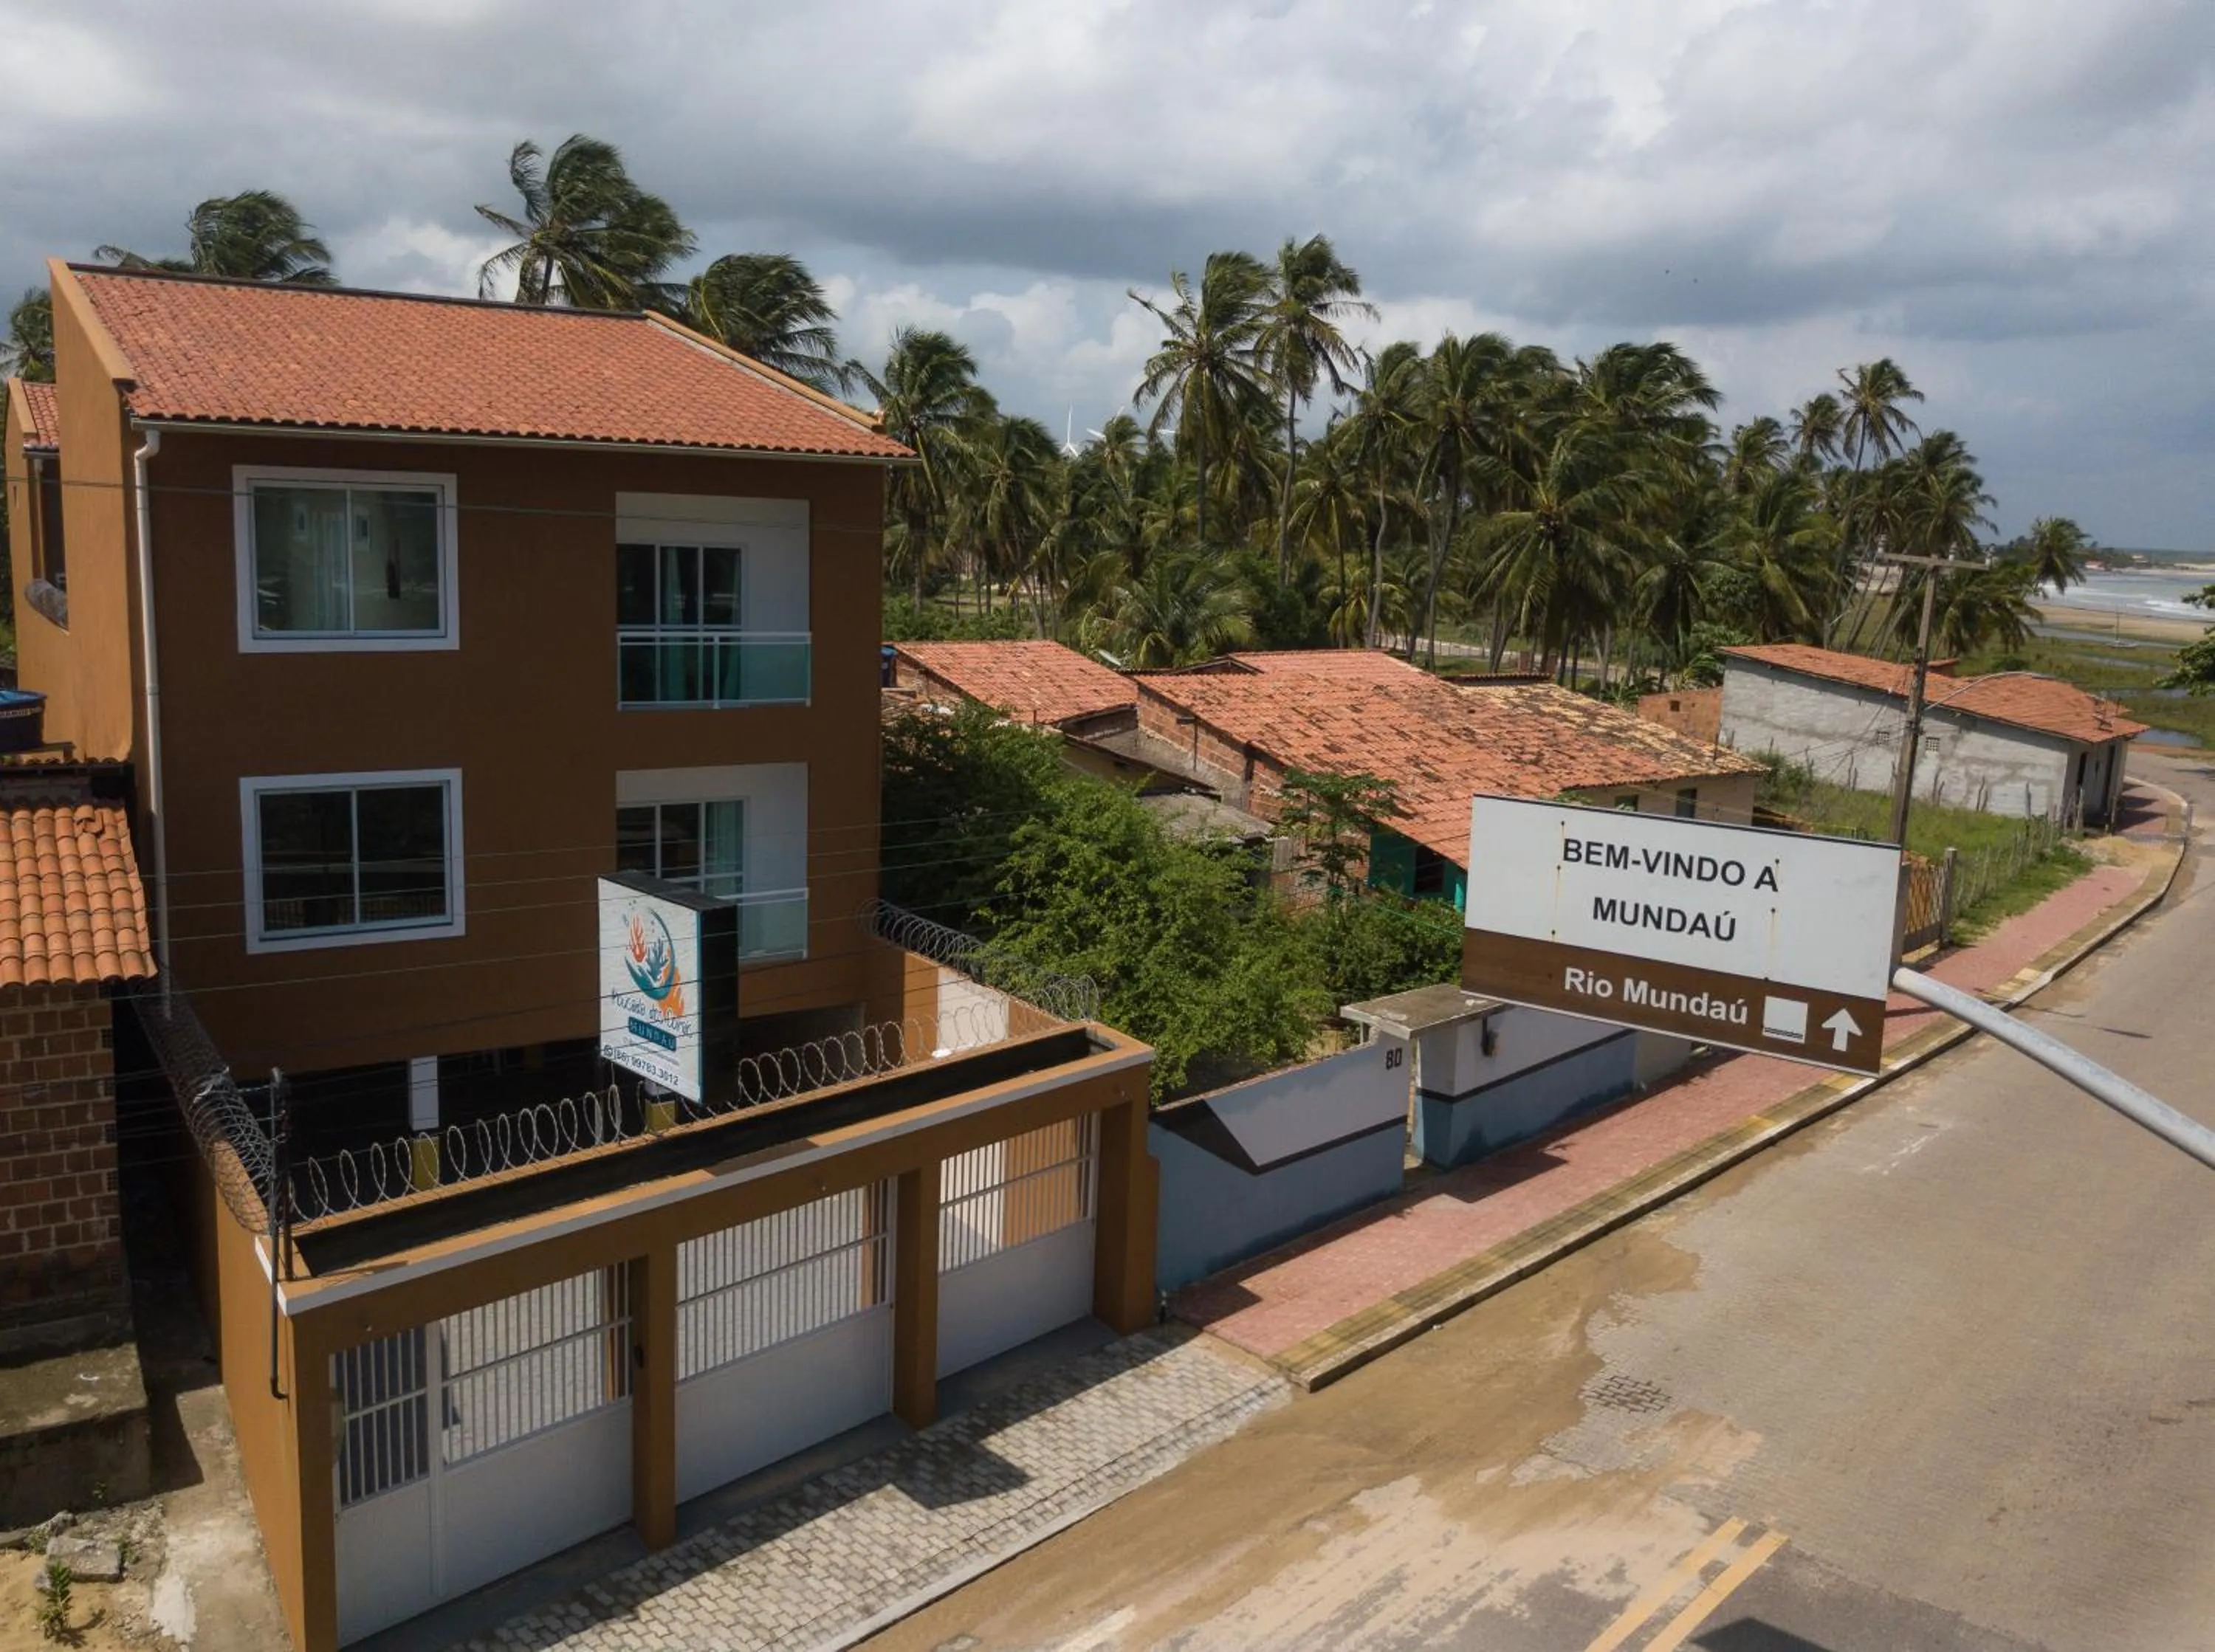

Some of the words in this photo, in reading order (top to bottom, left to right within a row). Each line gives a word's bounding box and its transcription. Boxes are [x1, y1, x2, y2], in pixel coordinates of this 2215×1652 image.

[1562, 837, 1745, 887] BEM-VINDO
[1754, 865, 1779, 892] A
[1592, 896, 1737, 942] MUNDAÚ
[1564, 966, 1613, 998] Rio
[1623, 977, 1748, 1025] Mundaú
